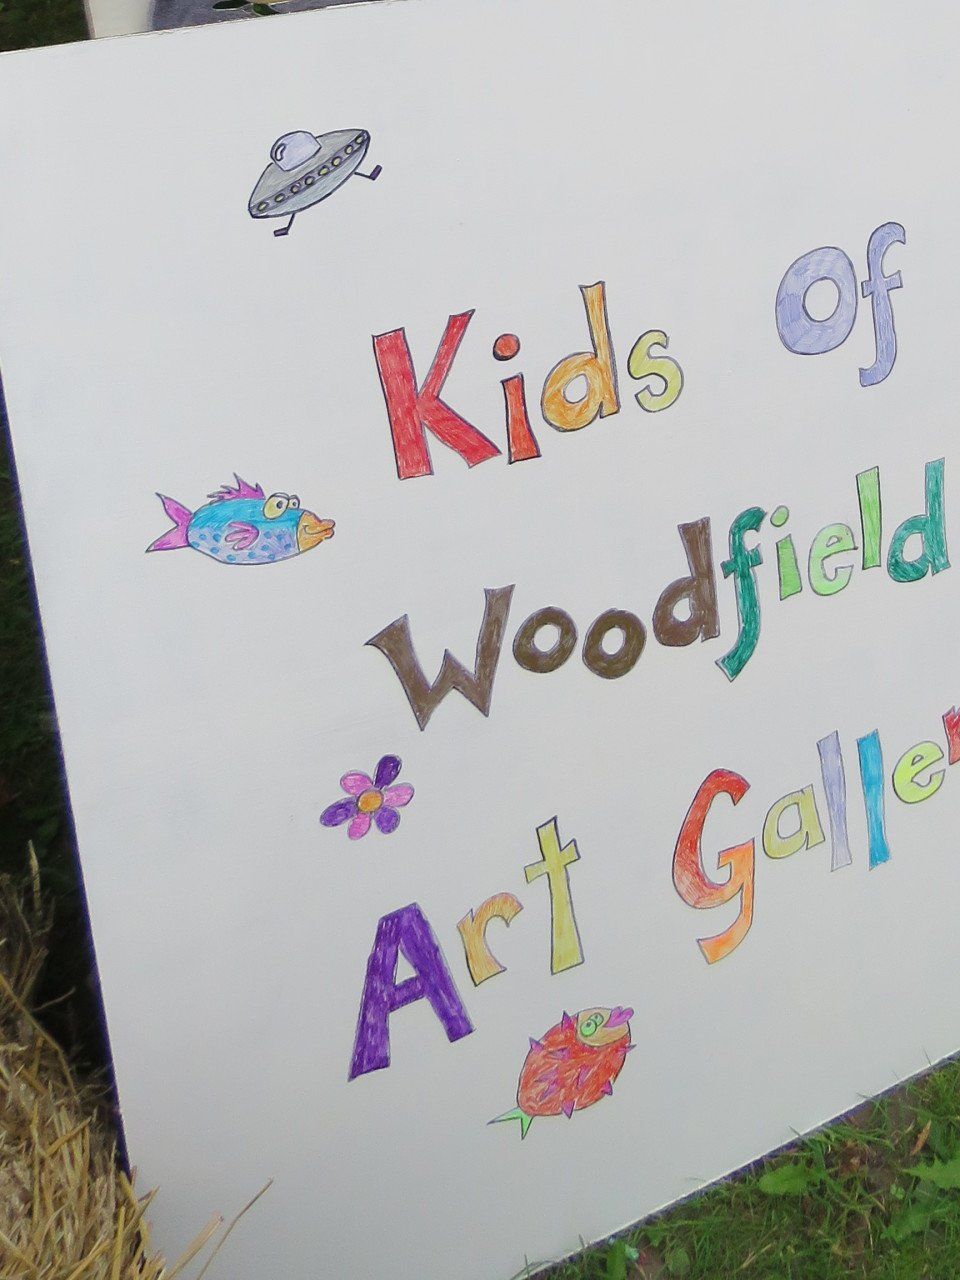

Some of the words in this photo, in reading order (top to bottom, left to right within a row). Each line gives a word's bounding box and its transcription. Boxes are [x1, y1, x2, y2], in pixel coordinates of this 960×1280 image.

[371, 280, 684, 480] Kids
[363, 457, 952, 732] Woodfield
[347, 815, 586, 1082] Art
